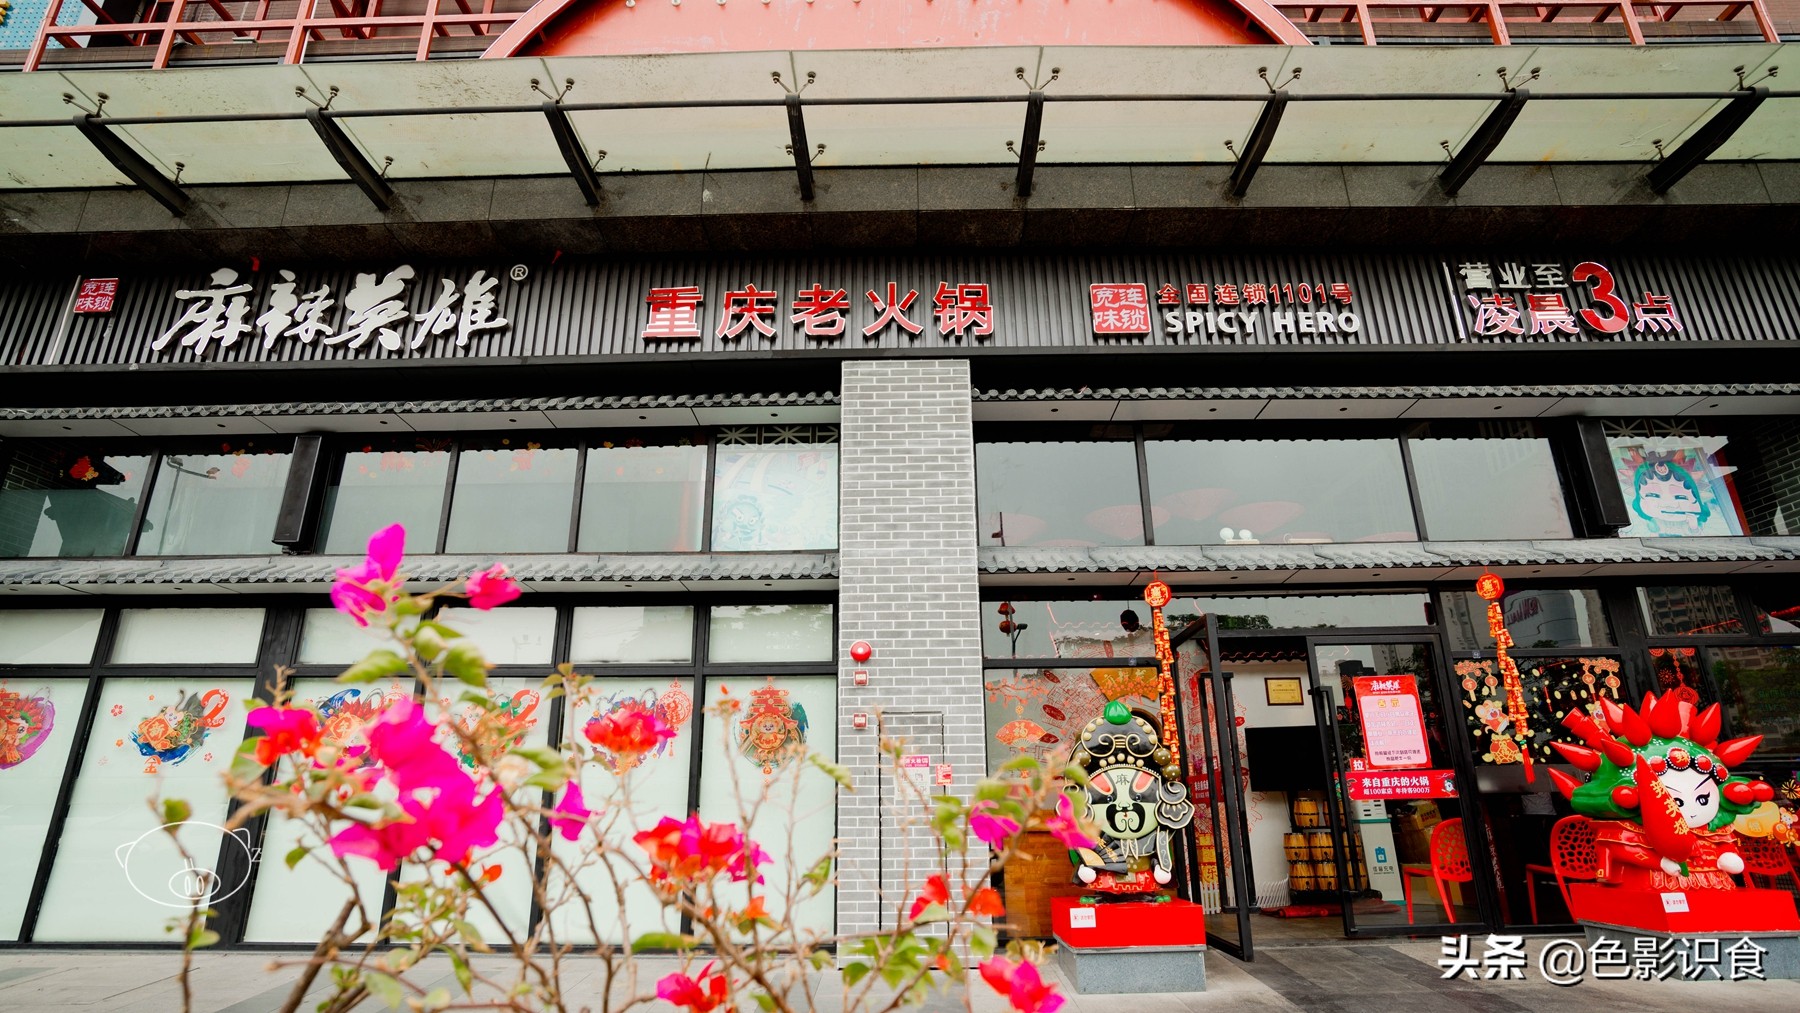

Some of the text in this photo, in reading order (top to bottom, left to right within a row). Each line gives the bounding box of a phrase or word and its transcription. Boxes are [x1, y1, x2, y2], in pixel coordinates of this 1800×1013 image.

[1458, 262, 1569, 289] 营业至
[1157, 283, 1353, 304] 全国连锁1101号
[1467, 261, 1683, 335] 凌晨3点
[152, 265, 508, 355] 麻辣英雄
[641, 281, 995, 339] 重庆老火锅
[1165, 311, 1360, 333] SPICY HERO
[1353, 759, 1364, 771] 拉
[1115, 773, 1130, 785] 麻
[1361, 776, 1430, 788] 来自重庆的火锅
